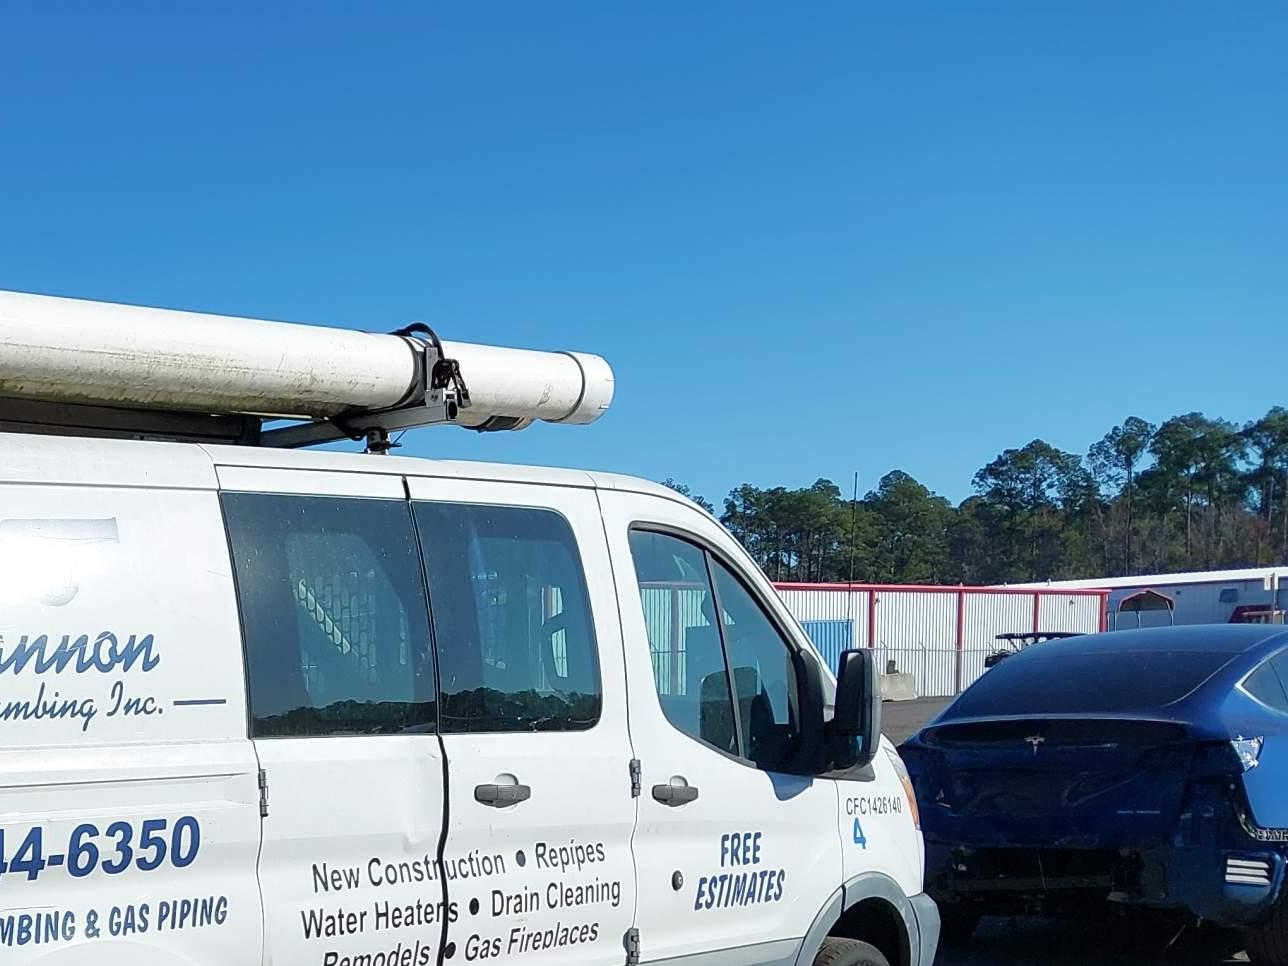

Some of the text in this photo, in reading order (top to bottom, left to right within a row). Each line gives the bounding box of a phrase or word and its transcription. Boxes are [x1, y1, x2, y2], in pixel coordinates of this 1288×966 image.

[106, 681, 163, 717] Inc.
[846, 796, 902, 815] CFC1426140
[720, 832, 762, 867] FREE
[853, 817, 867, 850] 4
[311, 839, 606, 893] New Construction Repipes
[300, 876, 621, 939] Water Heaters Drain Cleaning
[694, 869, 785, 911] ESTIMATES
[84, 909, 101, 939] &
[108, 903, 150, 937] GAS
[157, 896, 228, 931] PIPING
[464, 934, 503, 961] Gas
[507, 922, 600, 955] Fireplaces
